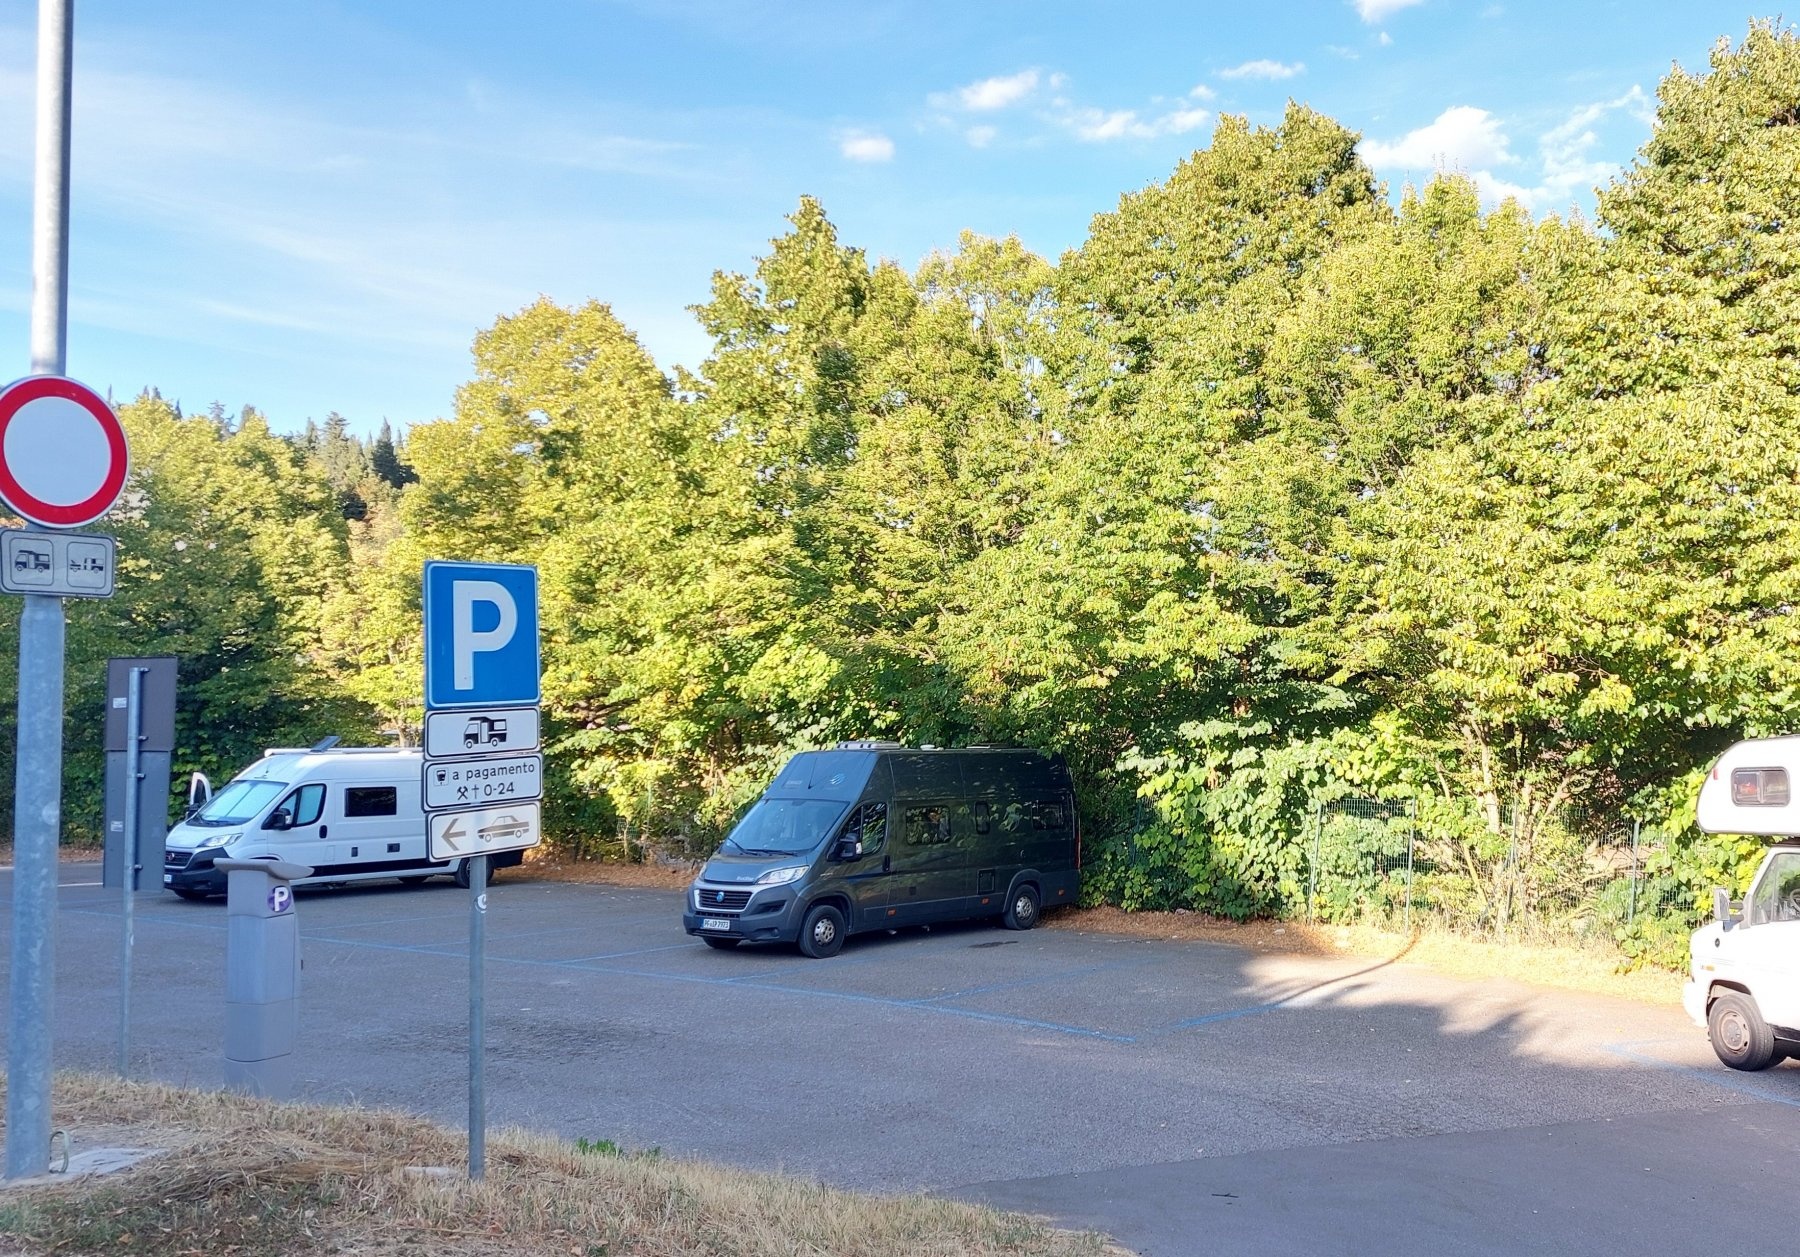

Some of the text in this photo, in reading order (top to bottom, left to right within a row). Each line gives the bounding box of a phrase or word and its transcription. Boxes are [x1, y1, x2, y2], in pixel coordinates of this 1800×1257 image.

[452, 580, 518, 691] P
[452, 762, 535, 781] a pagamento
[483, 782, 515, 796] 0-24
[274, 886, 289, 912] P
